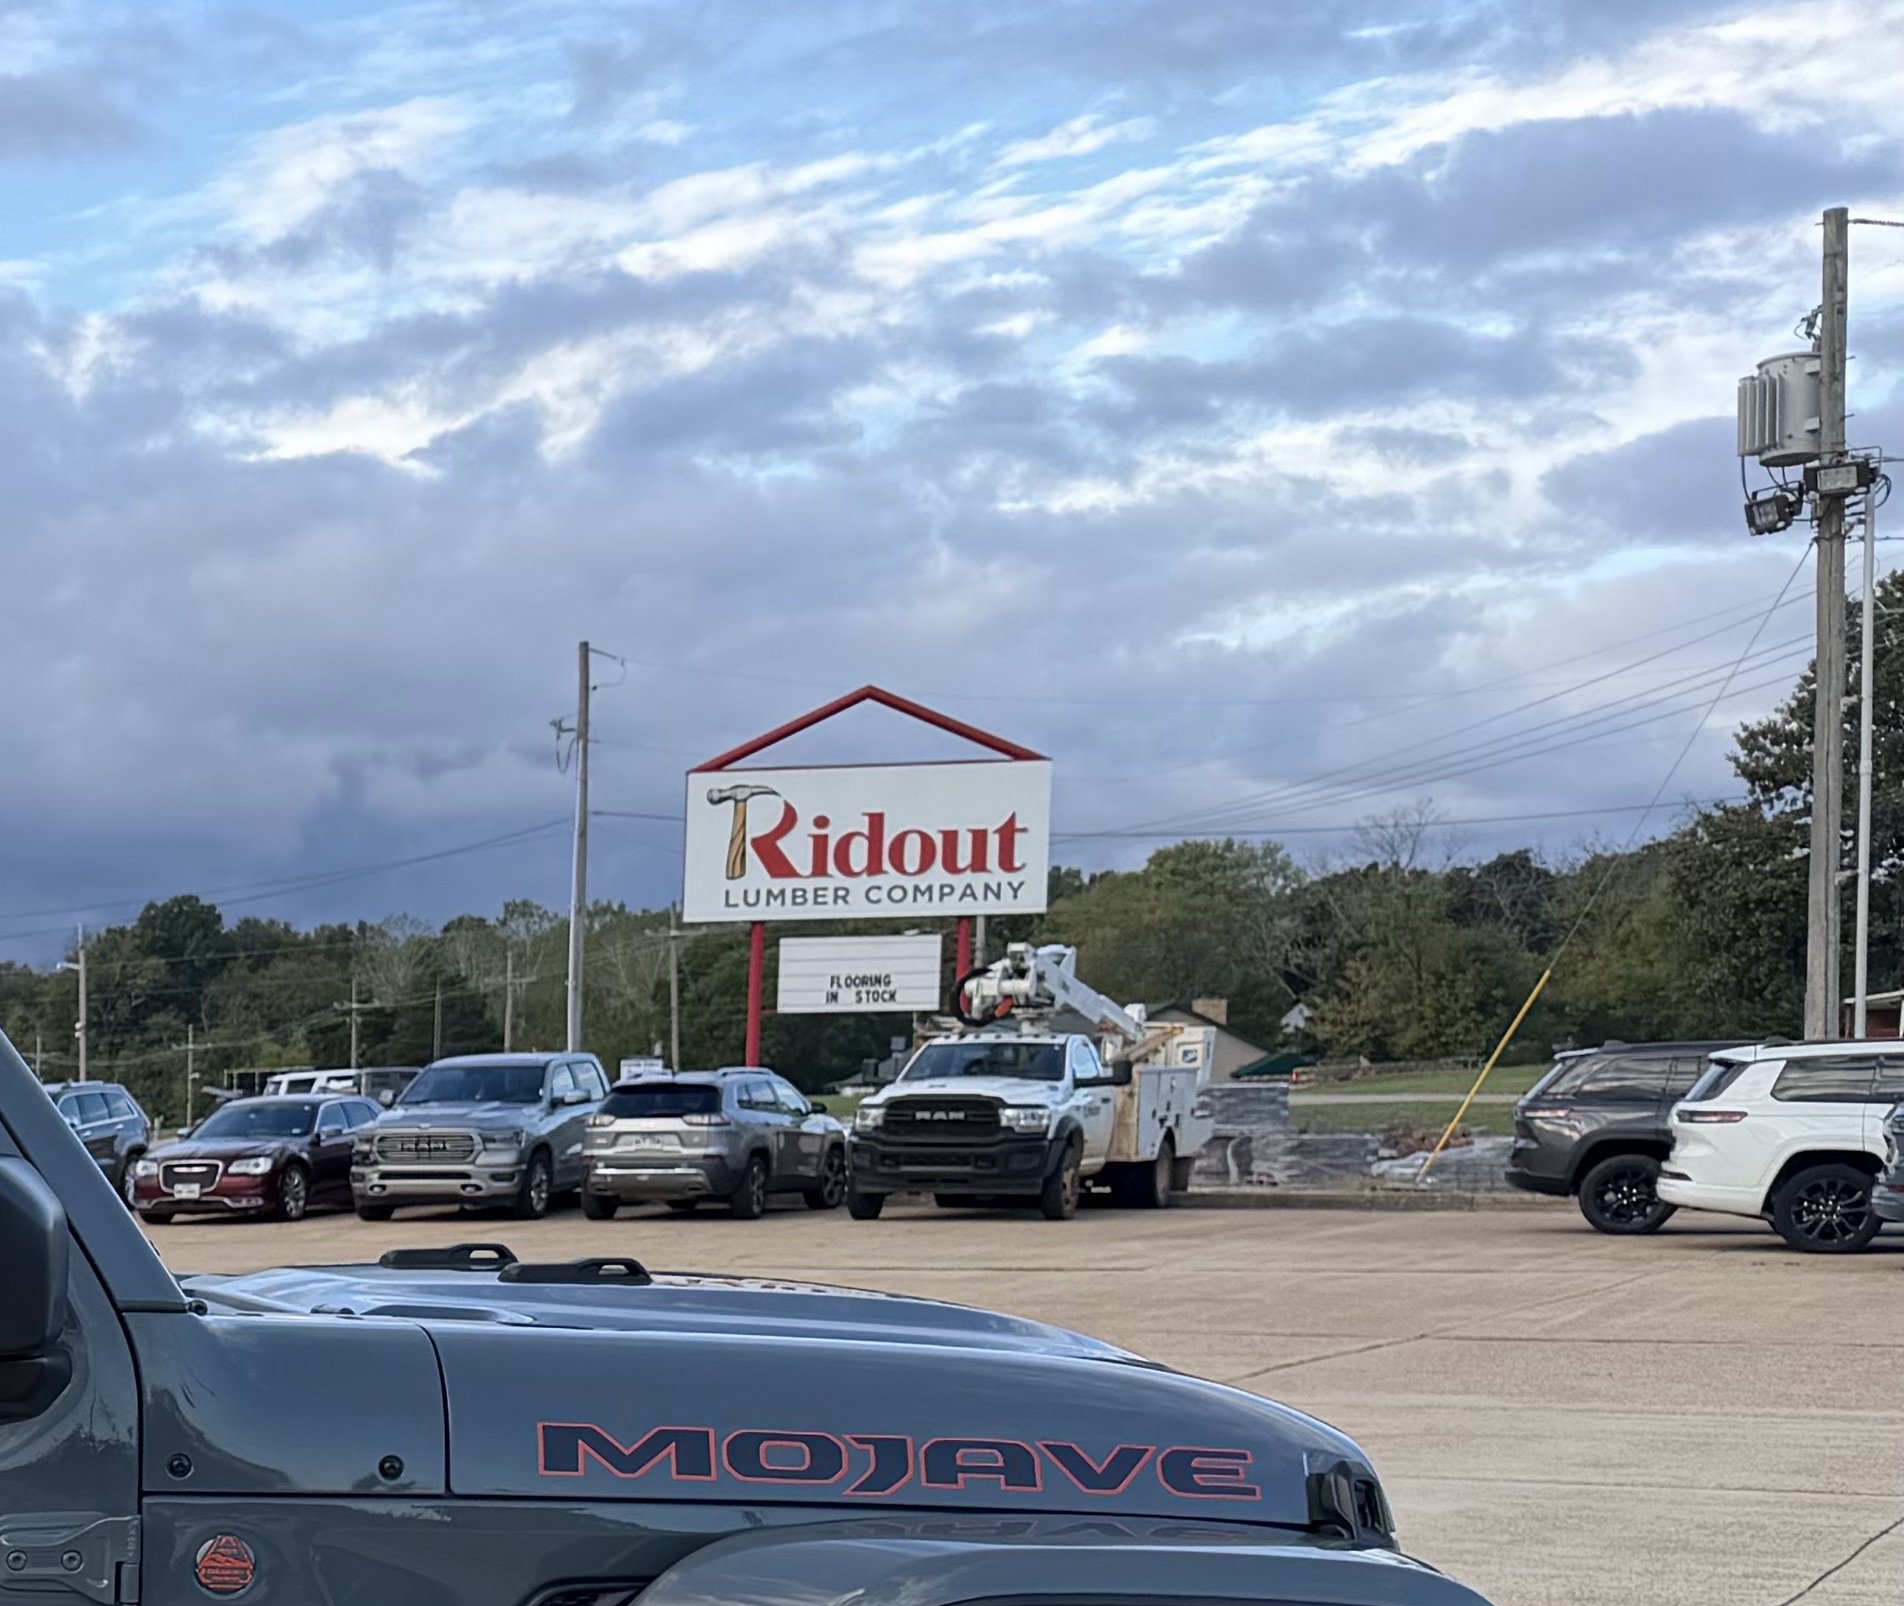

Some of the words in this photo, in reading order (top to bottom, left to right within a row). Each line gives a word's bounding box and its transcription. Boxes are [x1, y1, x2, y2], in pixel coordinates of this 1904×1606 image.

[706, 784, 1030, 881] Ridout
[723, 886, 850, 909] LUMBER
[864, 880, 1026, 906] COMPANY
[829, 974, 892, 989] FLOORING
[825, 990, 839, 1005] IN
[854, 988, 898, 1004] STOCK
[914, 1110, 966, 1121] RAM
[536, 1421, 1262, 1501] MOJAVE
